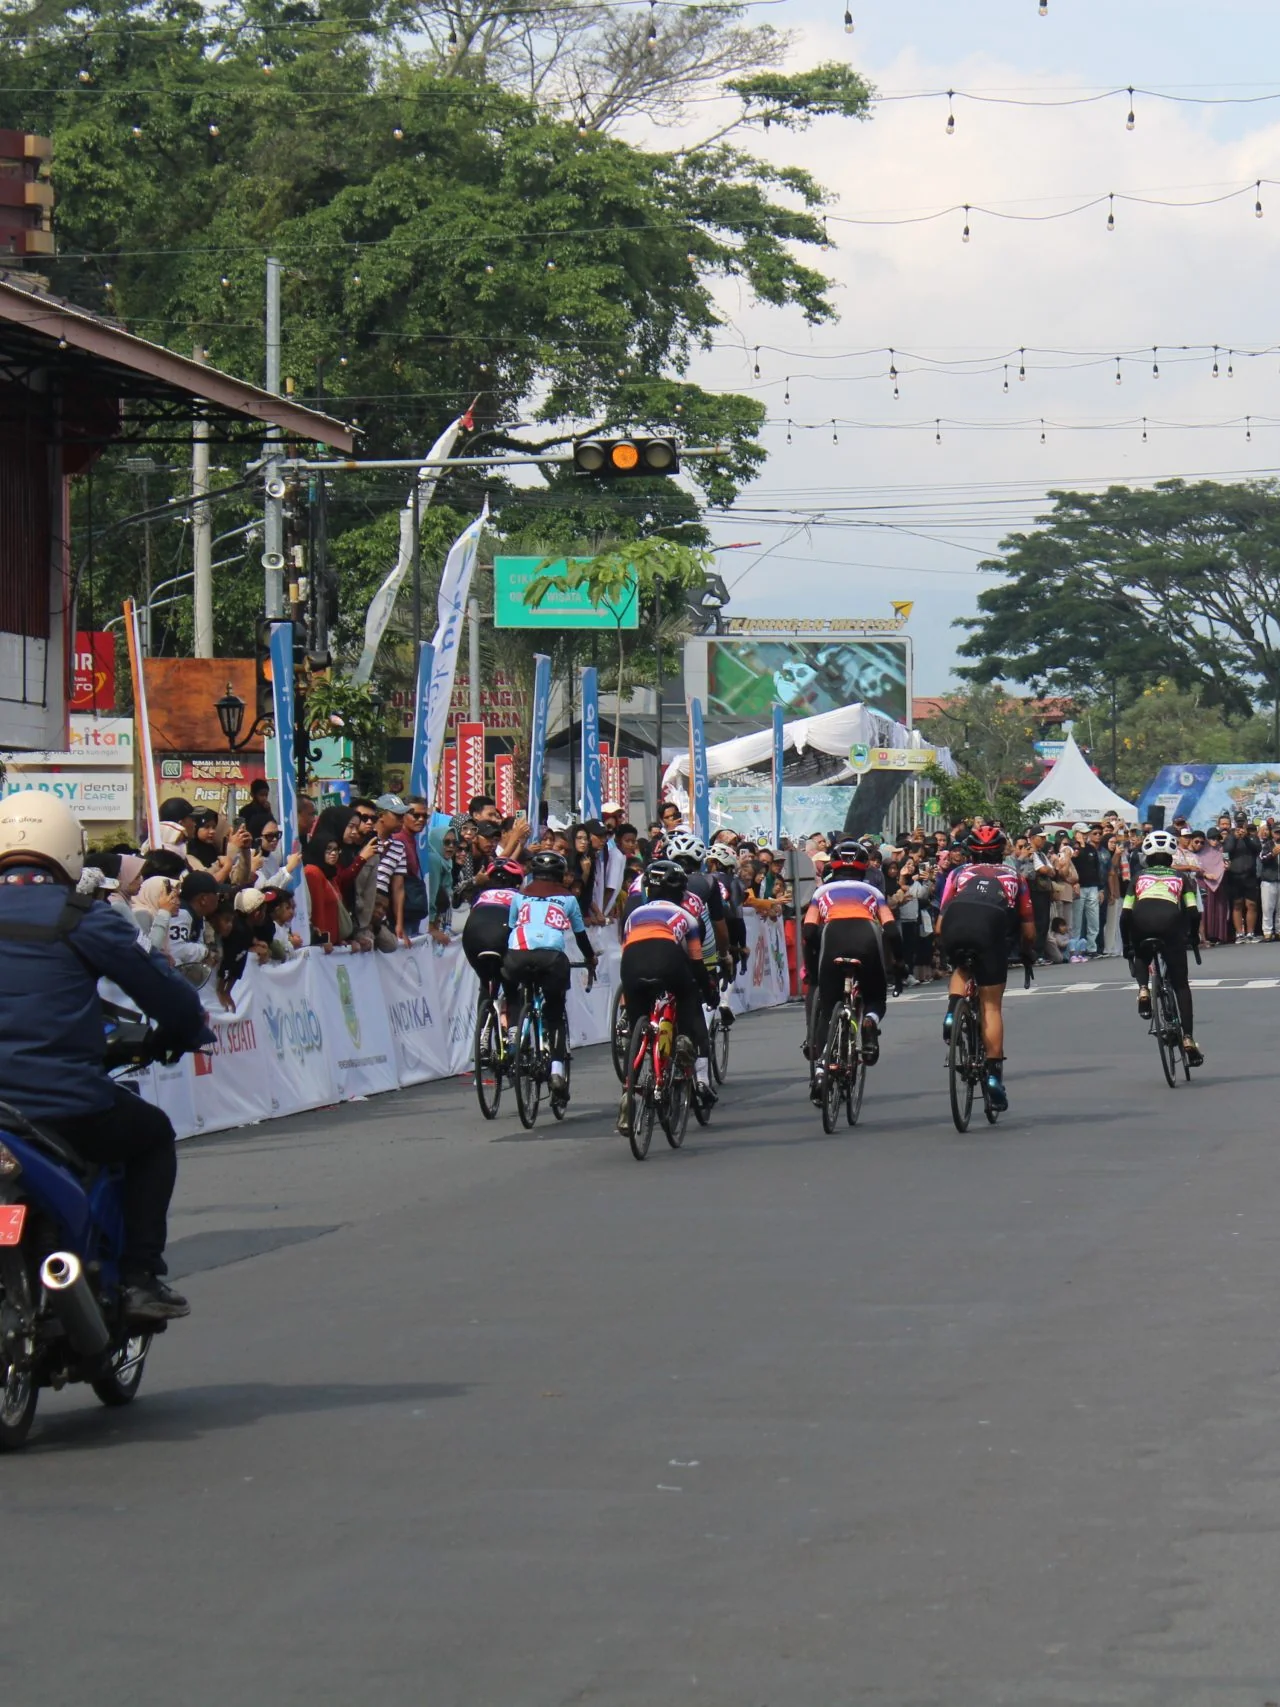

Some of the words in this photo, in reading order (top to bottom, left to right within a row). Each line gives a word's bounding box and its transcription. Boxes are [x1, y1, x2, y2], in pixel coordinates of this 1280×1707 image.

[84, 783, 128, 792] dental
[169, 924, 189, 941] 33
[9, 1209, 21, 1225] Z
